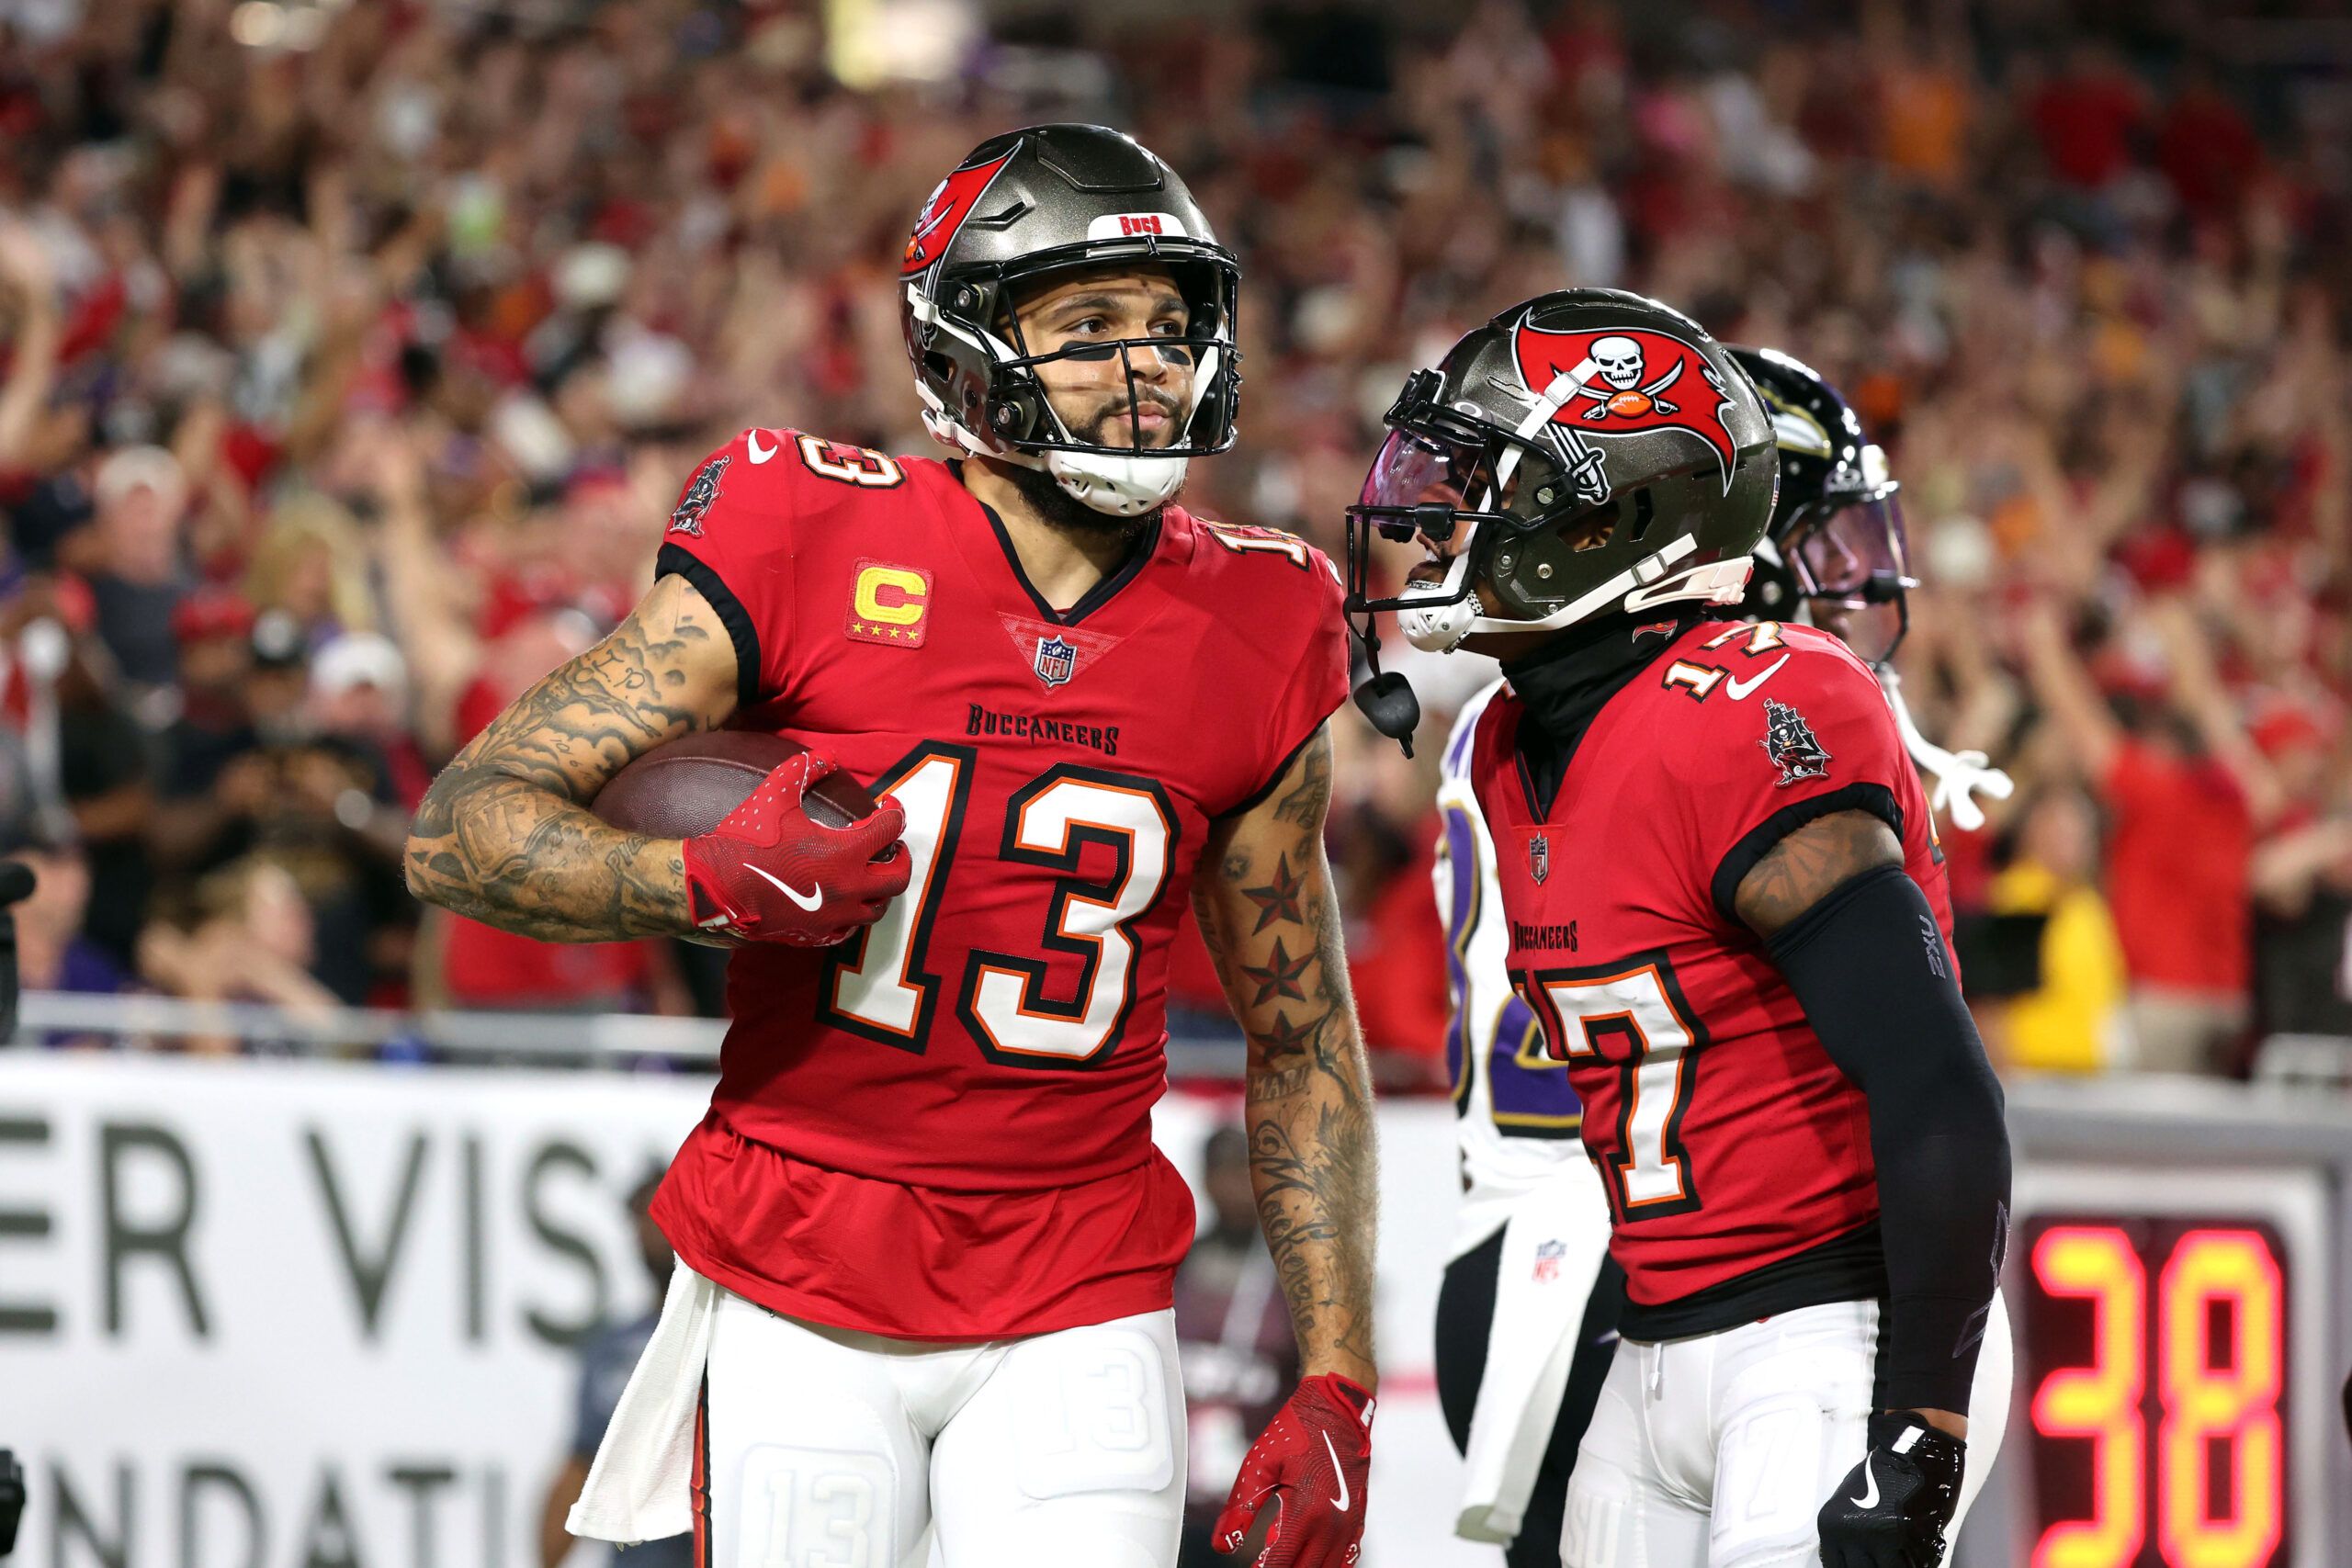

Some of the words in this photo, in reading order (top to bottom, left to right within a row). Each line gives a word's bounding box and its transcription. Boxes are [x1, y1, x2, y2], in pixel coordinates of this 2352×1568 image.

[854, 567, 926, 626] C
[1040, 655, 1069, 678] NFL
[1661, 620, 1790, 704] 17
[966, 703, 1119, 756] BUCCANEERS
[815, 739, 1182, 1070] 13
[1513, 919, 1578, 956] BUCCANEERS
[1918, 914, 1946, 979] 2XU
[1509, 948, 1712, 1225] 7
[2031, 1227, 2281, 1568] 38
